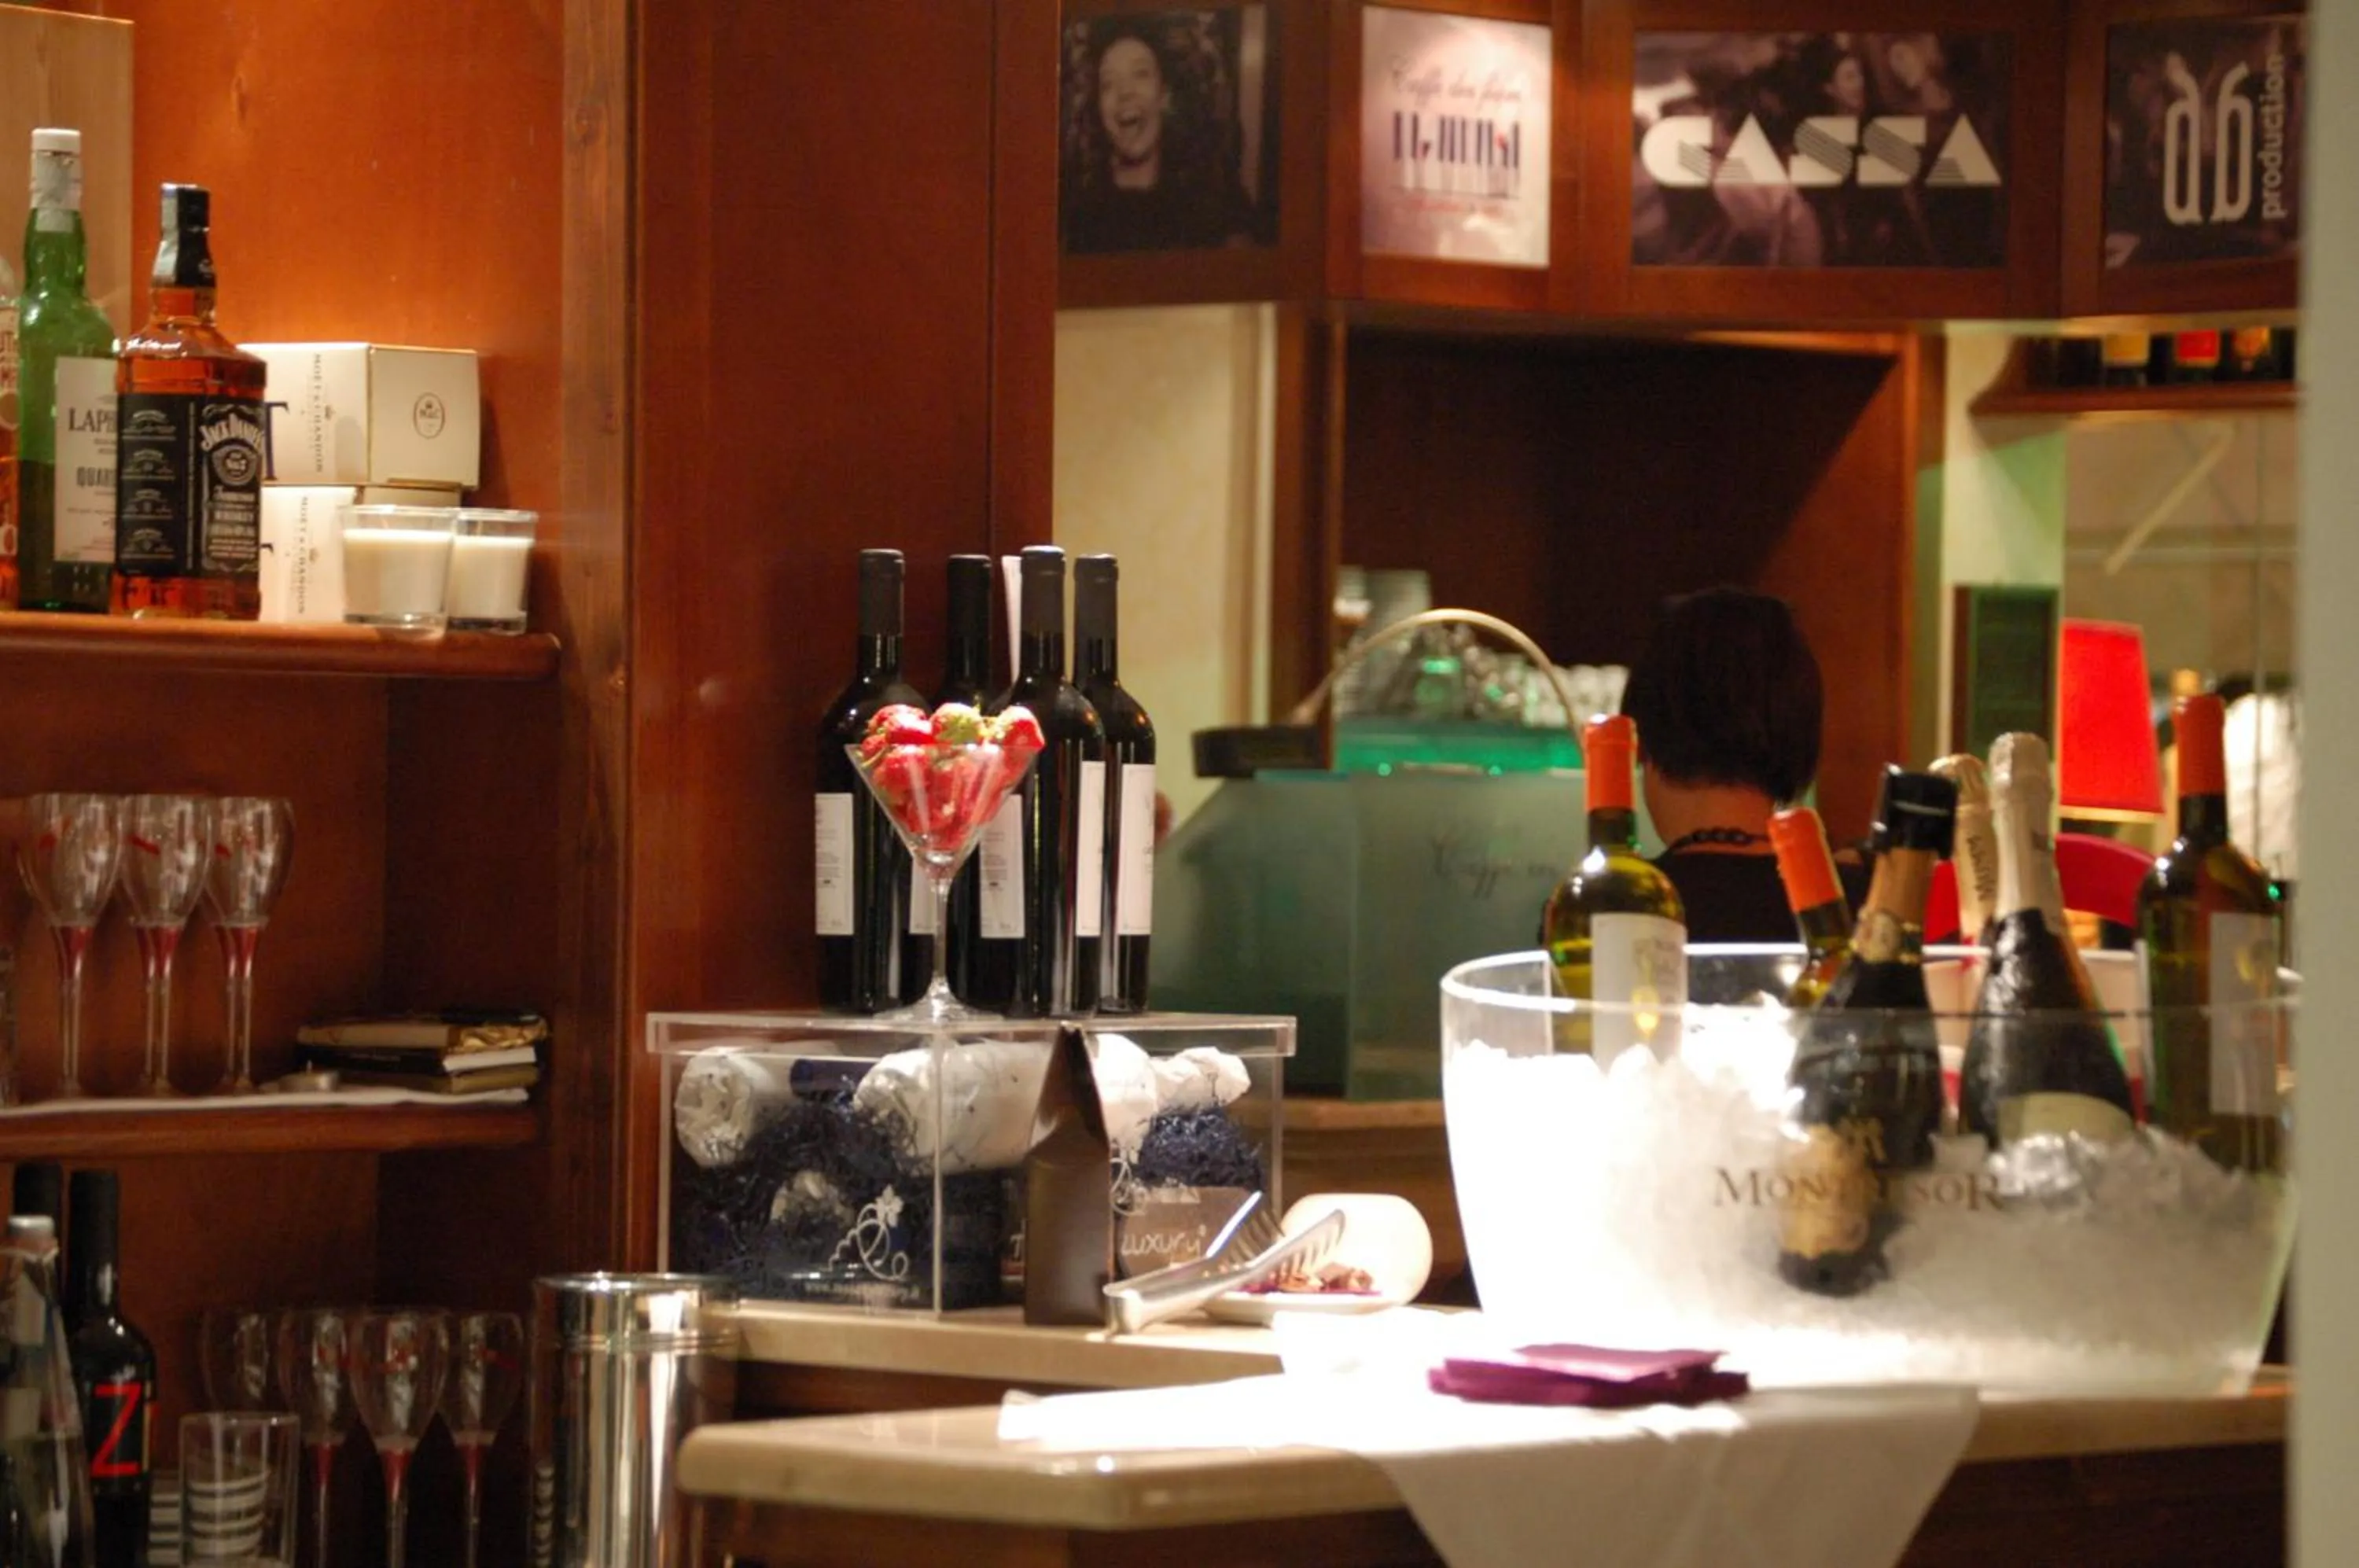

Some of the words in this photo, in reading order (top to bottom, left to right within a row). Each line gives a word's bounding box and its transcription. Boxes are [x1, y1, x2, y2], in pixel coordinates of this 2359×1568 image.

[1641, 112, 2001, 188] CASSA
[2257, 52, 2287, 219] production
[90, 1382, 142, 1478] Z
